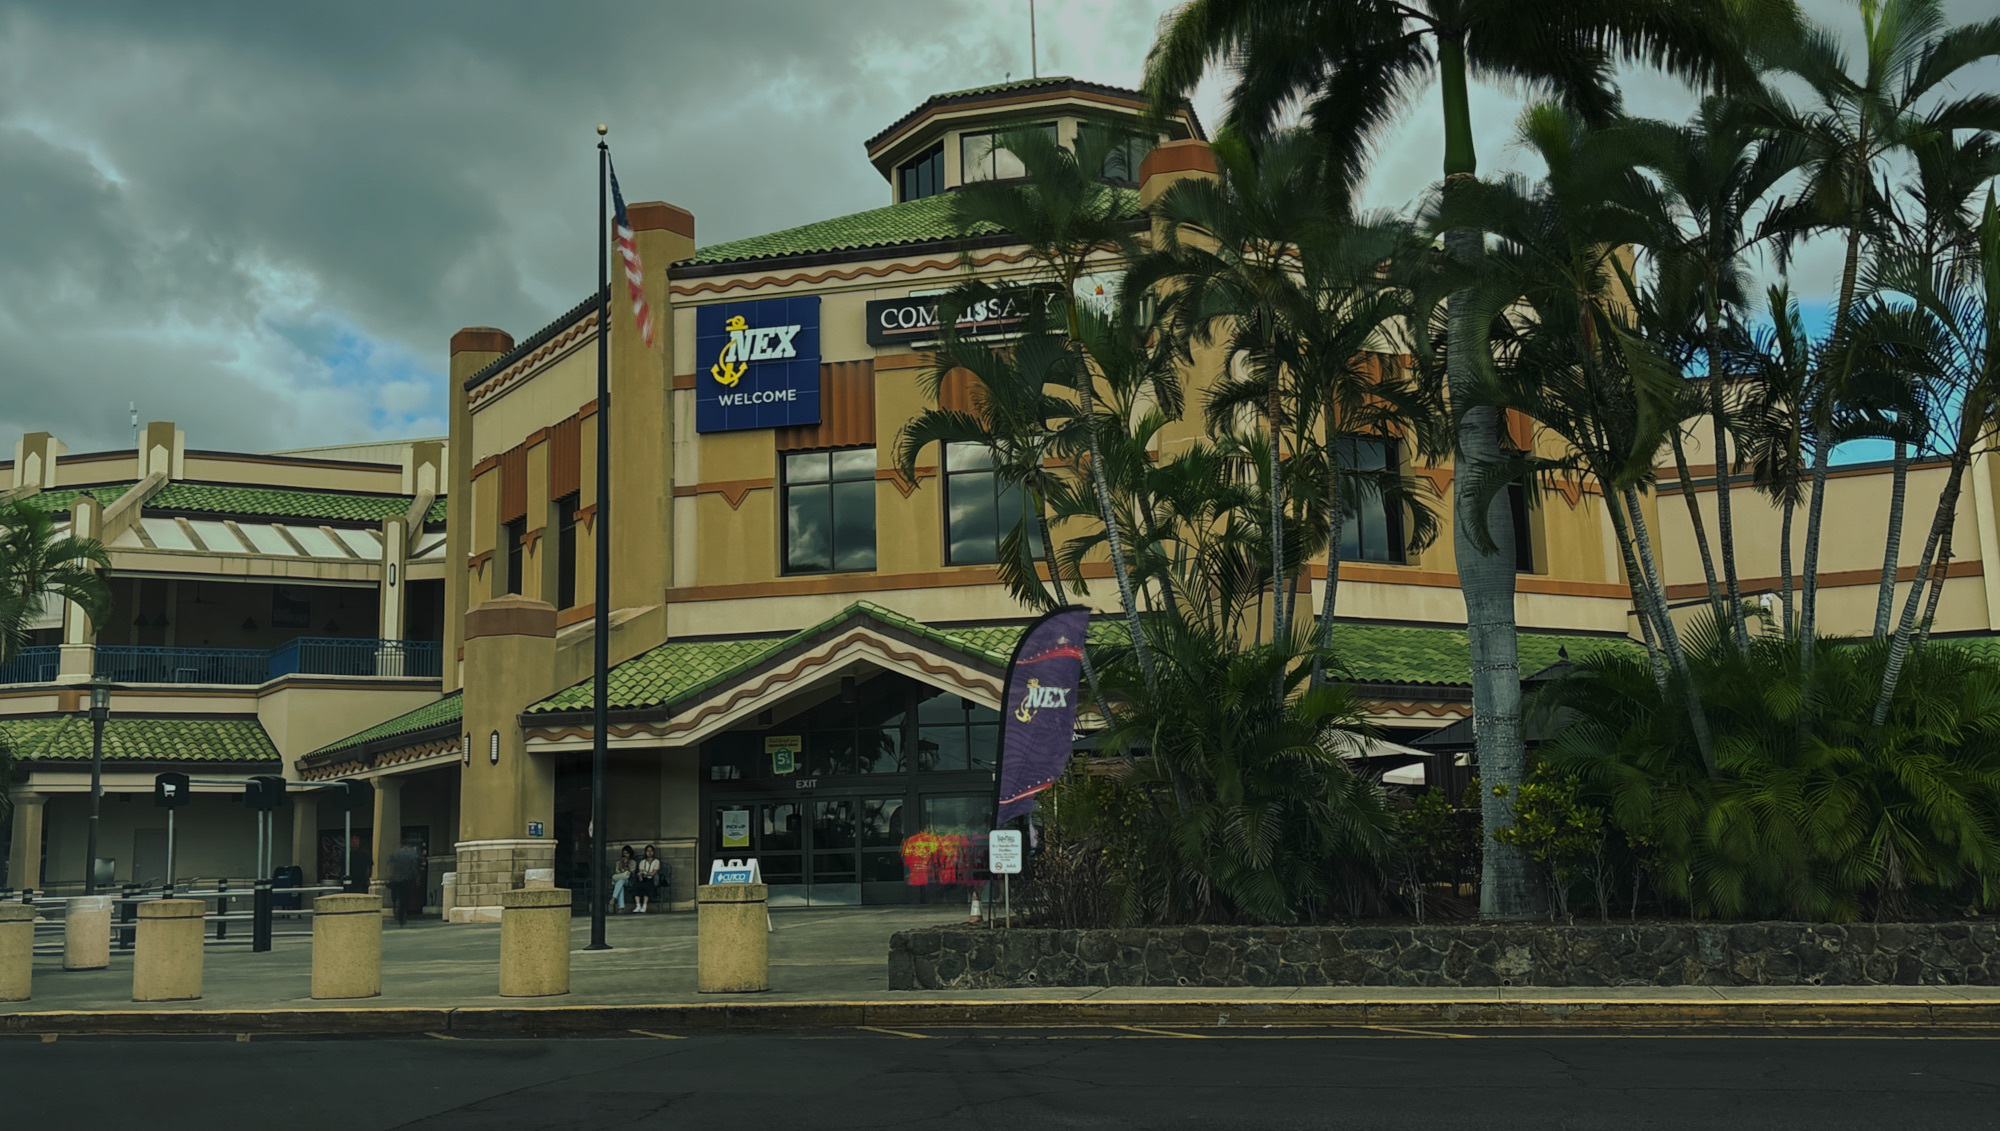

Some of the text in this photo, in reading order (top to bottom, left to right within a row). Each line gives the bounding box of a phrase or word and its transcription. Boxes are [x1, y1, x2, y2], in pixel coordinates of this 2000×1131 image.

[880, 292, 1056, 329] COMISSAY
[725, 325, 802, 362] NEX
[718, 388, 797, 407] WELCOME
[1024, 686, 1072, 709] NEX
[795, 778, 818, 789] EXIT
